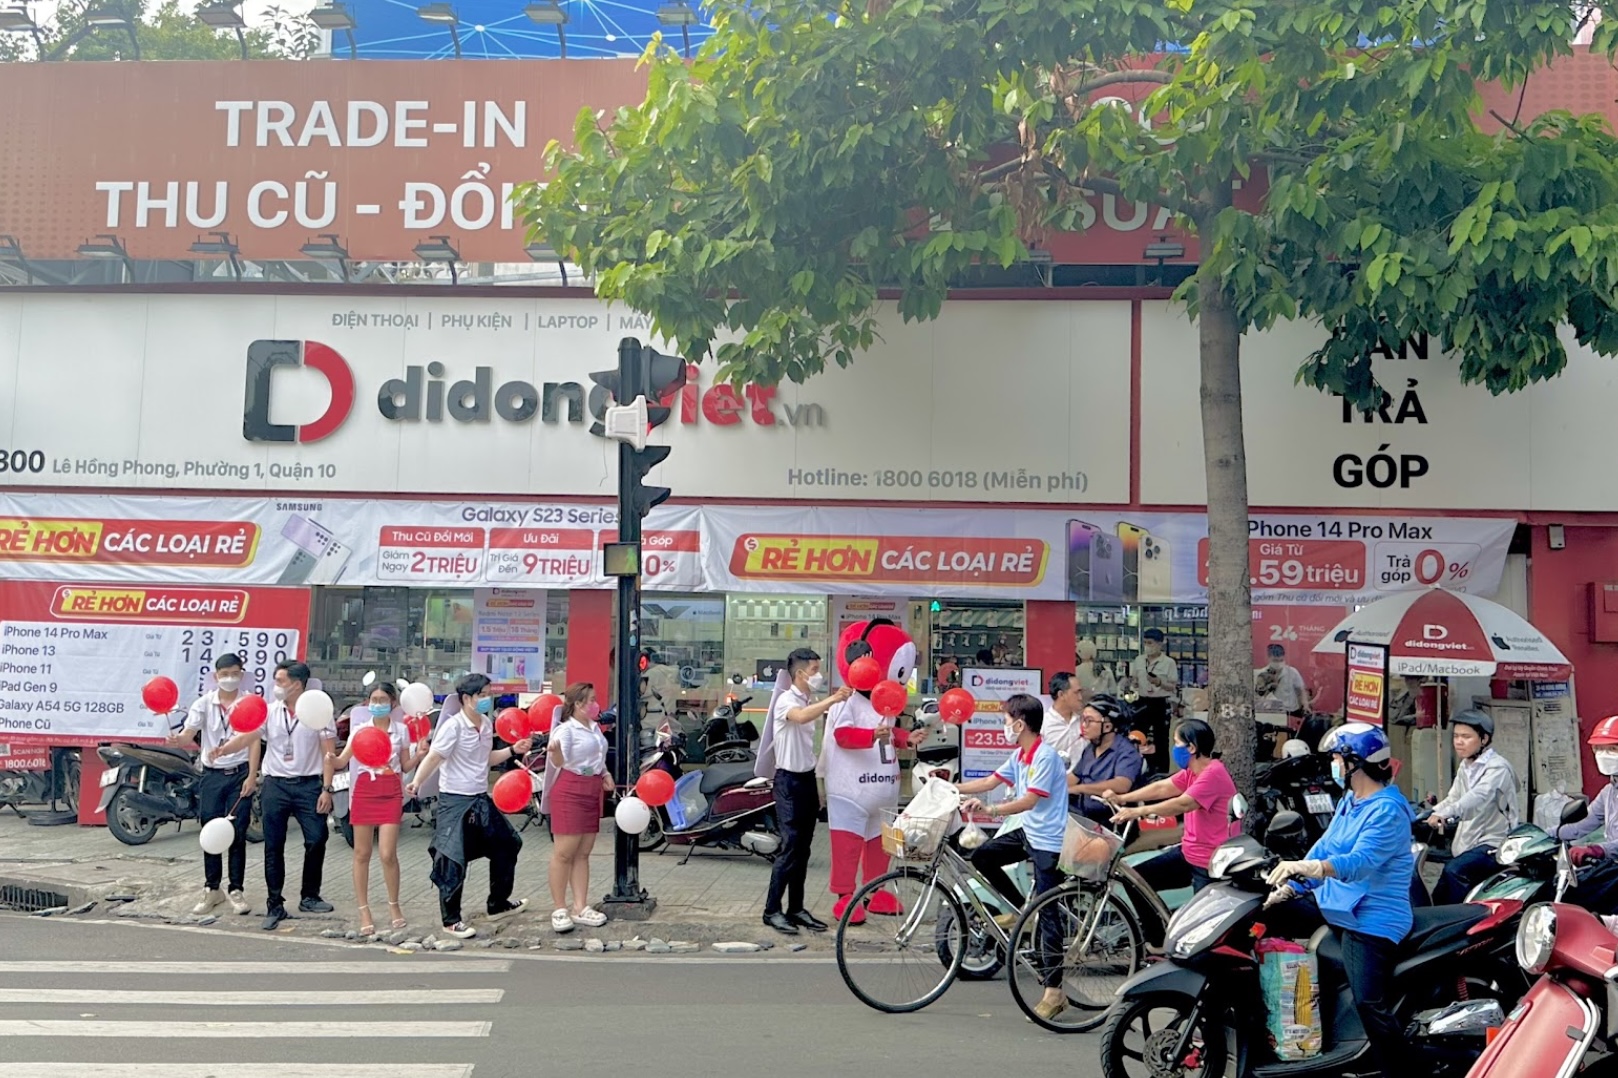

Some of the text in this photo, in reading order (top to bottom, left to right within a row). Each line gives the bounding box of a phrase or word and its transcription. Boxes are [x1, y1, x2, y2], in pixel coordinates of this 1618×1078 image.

[215, 101, 526, 147] TRADE-IN
[96, 181, 228, 228] THU
[247, 169, 336, 229] CŨ
[332, 312, 367, 330] ĐIỆN
[371, 313, 418, 330] THOẠI
[441, 315, 473, 330] PHỤ
[477, 312, 512, 331] KIỆN
[538, 315, 598, 329] LAPTOP
[53, 458, 71, 474] Lê
[75, 458, 118, 478] Hồng
[122, 460, 180, 479] Phong,
[183, 460, 250, 480] Phường
[269, 463, 313, 482] Quận
[318, 463, 336, 478] 10
[1333, 443, 1429, 489] GÓP
[788, 467, 1088, 492] Hotline: 1800 6018 (Miễn phí)
[276, 502, 323, 512] SAMSUNG
[461, 506, 530, 526] Galaxy
[533, 508, 563, 523] S23
[392, 530, 474, 543] Thu Cũ Đổi Mới
[1249, 520, 1432, 540] Phone 14 Pro Max
[0, 521, 246, 560] RẺ HƠN CÁC LOẠI RẺ
[522, 532, 559, 544] Ưu Đãi
[649, 535, 673, 547] Góp
[383, 549, 409, 561] Giảm
[1260, 543, 1304, 556] Giá Từ
[504, 552, 519, 564] Giá
[761, 539, 1034, 578] RẺ HƠN CÁC LOẠI RẺ
[1387, 554, 1411, 568] Trả
[382, 561, 408, 573] Ngay
[498, 562, 518, 574] Đến
[1381, 568, 1411, 584] góp
[71, 590, 239, 615] RẺ HƠN CÁC LOẠI RẺ
[4, 625, 41, 638] iPhone
[44, 627, 58, 638] 14
[61, 627, 80, 639] Pro
[83, 628, 108, 640] Max
[1269, 624, 1298, 641] 24
[2, 644, 39, 656] iPhone
[42, 645, 56, 656] 13
[40, 664, 52, 674] 11
[1397, 662, 1481, 677] iPad/Macbook
[23, 681, 47, 692] Gen
[49, 682, 57, 693] 9
[36, 700, 60, 712] A54
[64, 701, 81, 712] 5G
[85, 702, 125, 714] 128GB
[35, 718, 51, 730] Cũ
